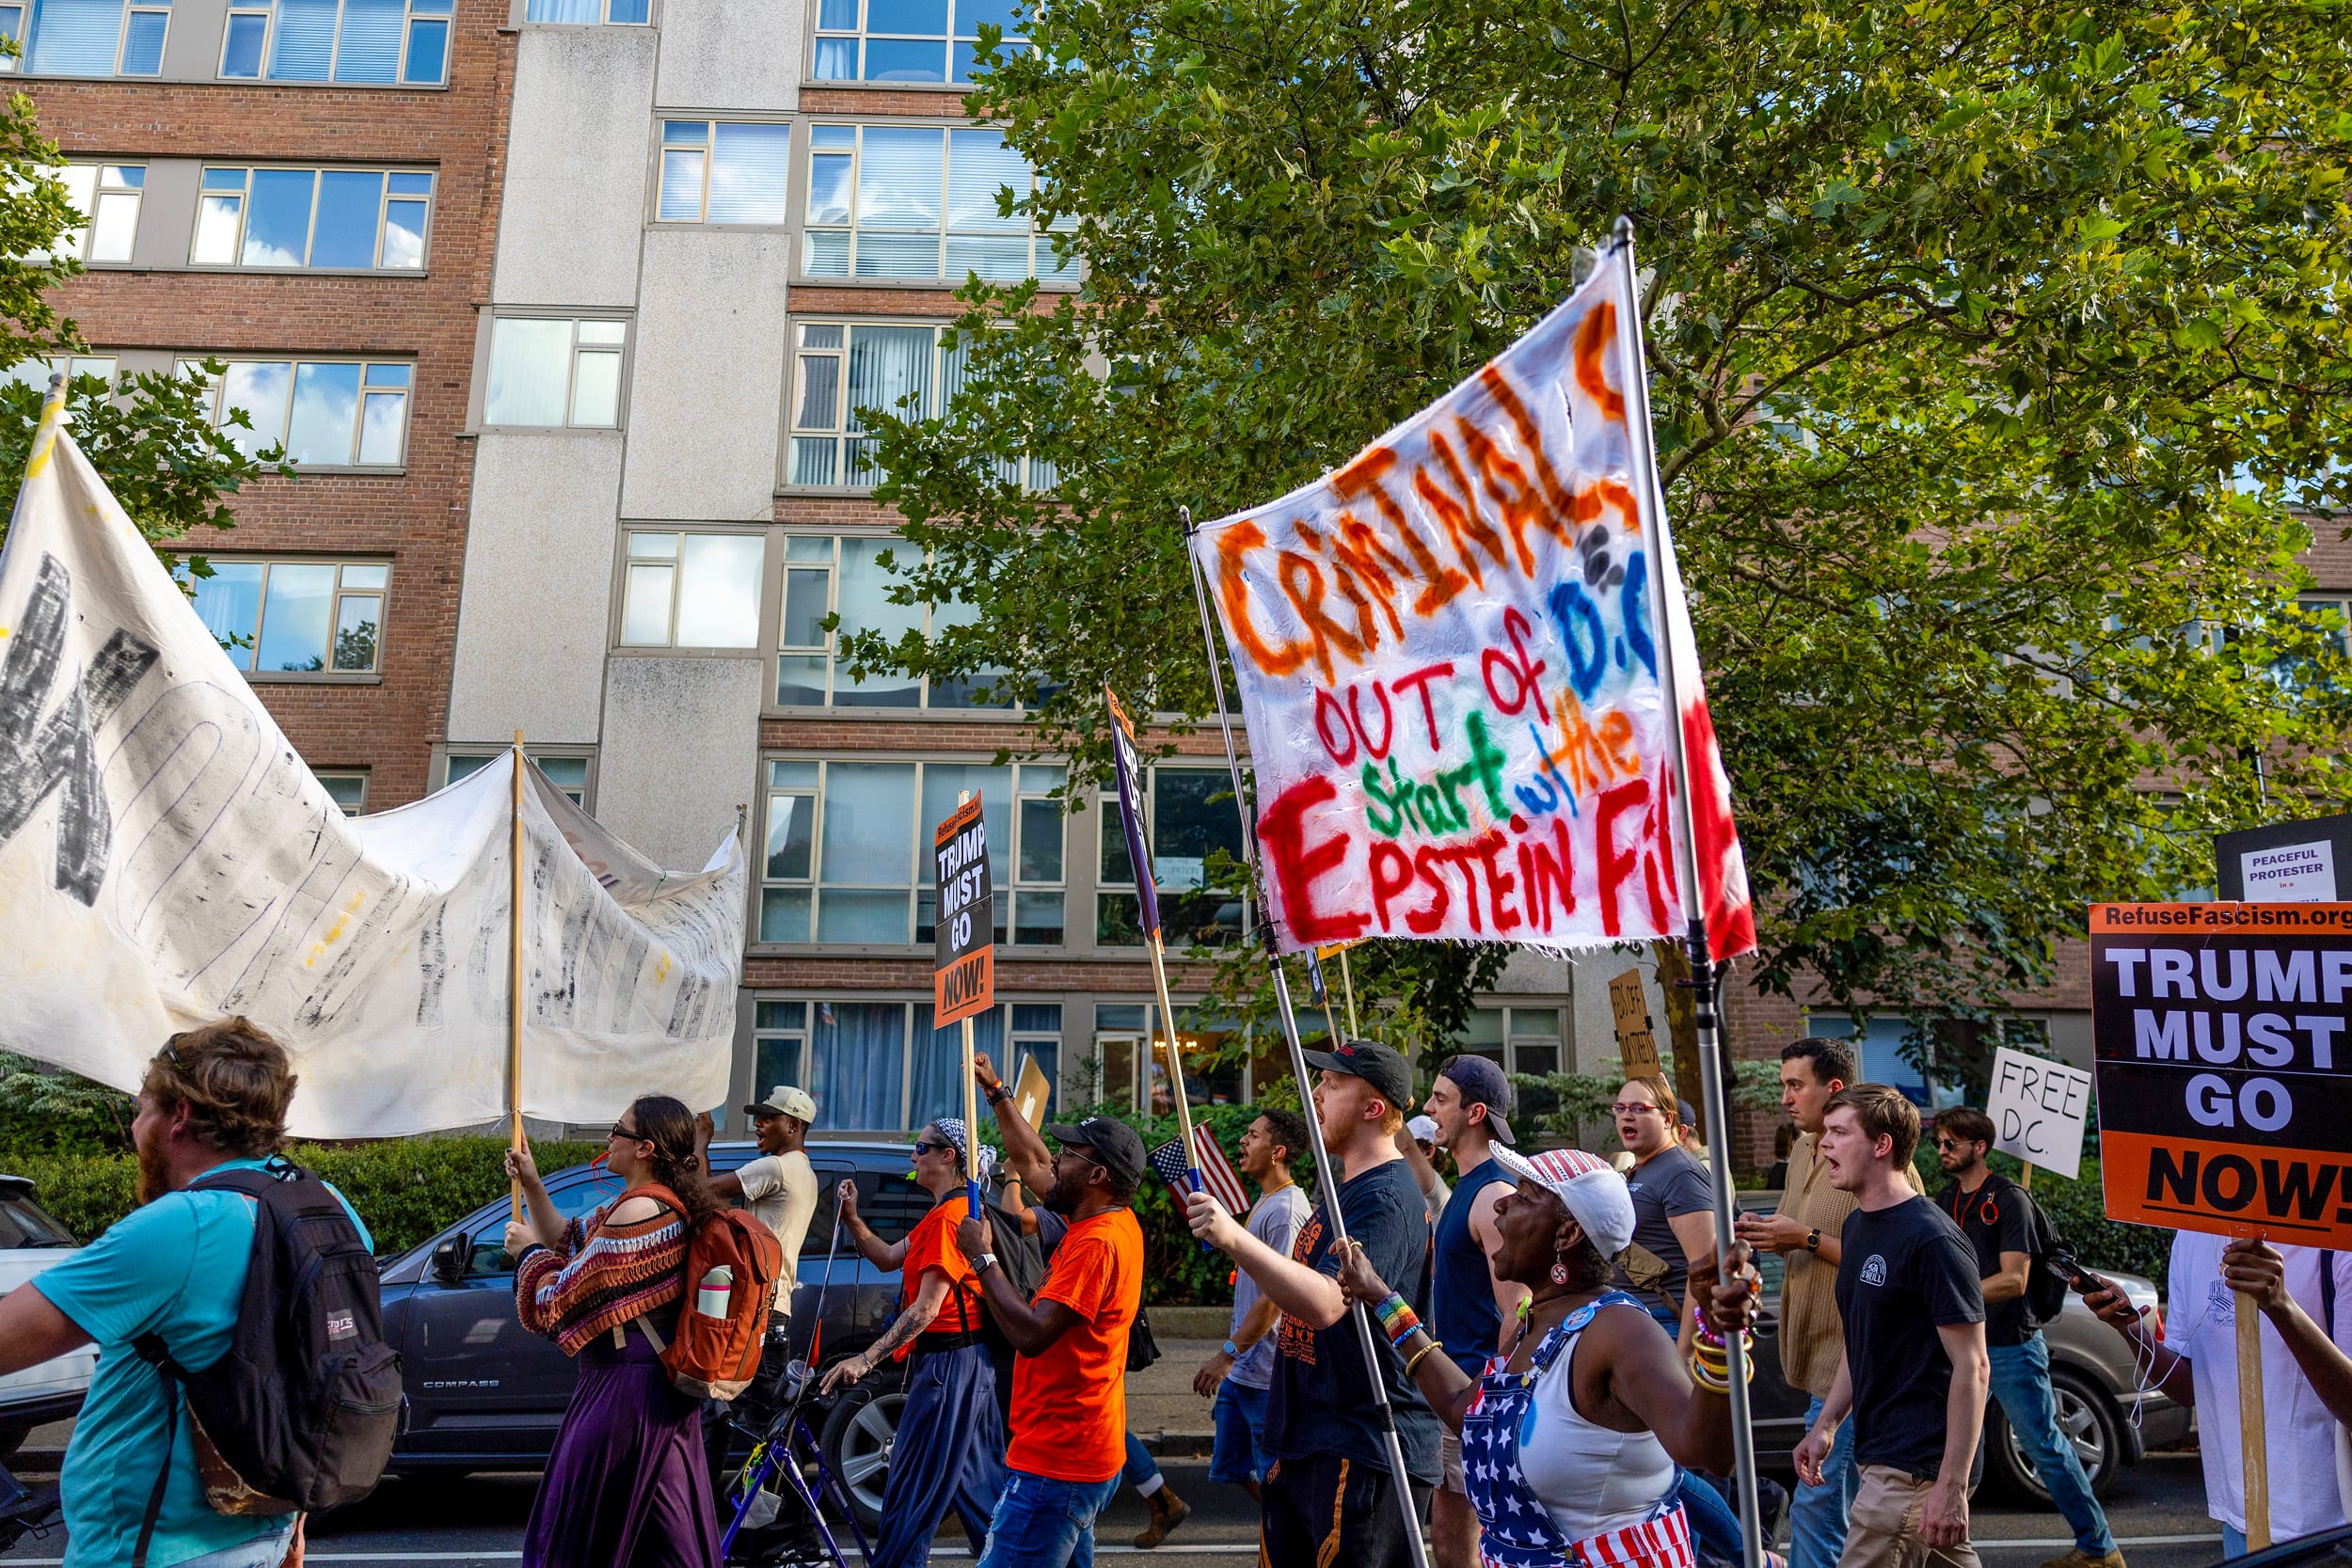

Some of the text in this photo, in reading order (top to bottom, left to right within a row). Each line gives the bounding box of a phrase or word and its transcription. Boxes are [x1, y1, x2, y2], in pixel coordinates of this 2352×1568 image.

[1315, 661, 1454, 768] OUT
[939, 821, 985, 882] TRUMP
[2249, 863, 2324, 881] PROTESTER
[2252, 849, 2318, 866] PEACEFUL
[943, 864, 983, 920] MUST
[2106, 905, 2352, 930] RefuseFascism.org
[951, 911, 972, 953] GO
[943, 955, 985, 1010] NOW!
[2106, 948, 2352, 1004] TRUMP
[2133, 1008, 2345, 1069] MUST
[1998, 1060, 2090, 1121] FREE
[2185, 1072, 2293, 1132] GO
[2002, 1107, 2050, 1155] D.C.
[2146, 1147, 2352, 1224] NOW!
[423, 1380, 500, 1388] COMPASS
